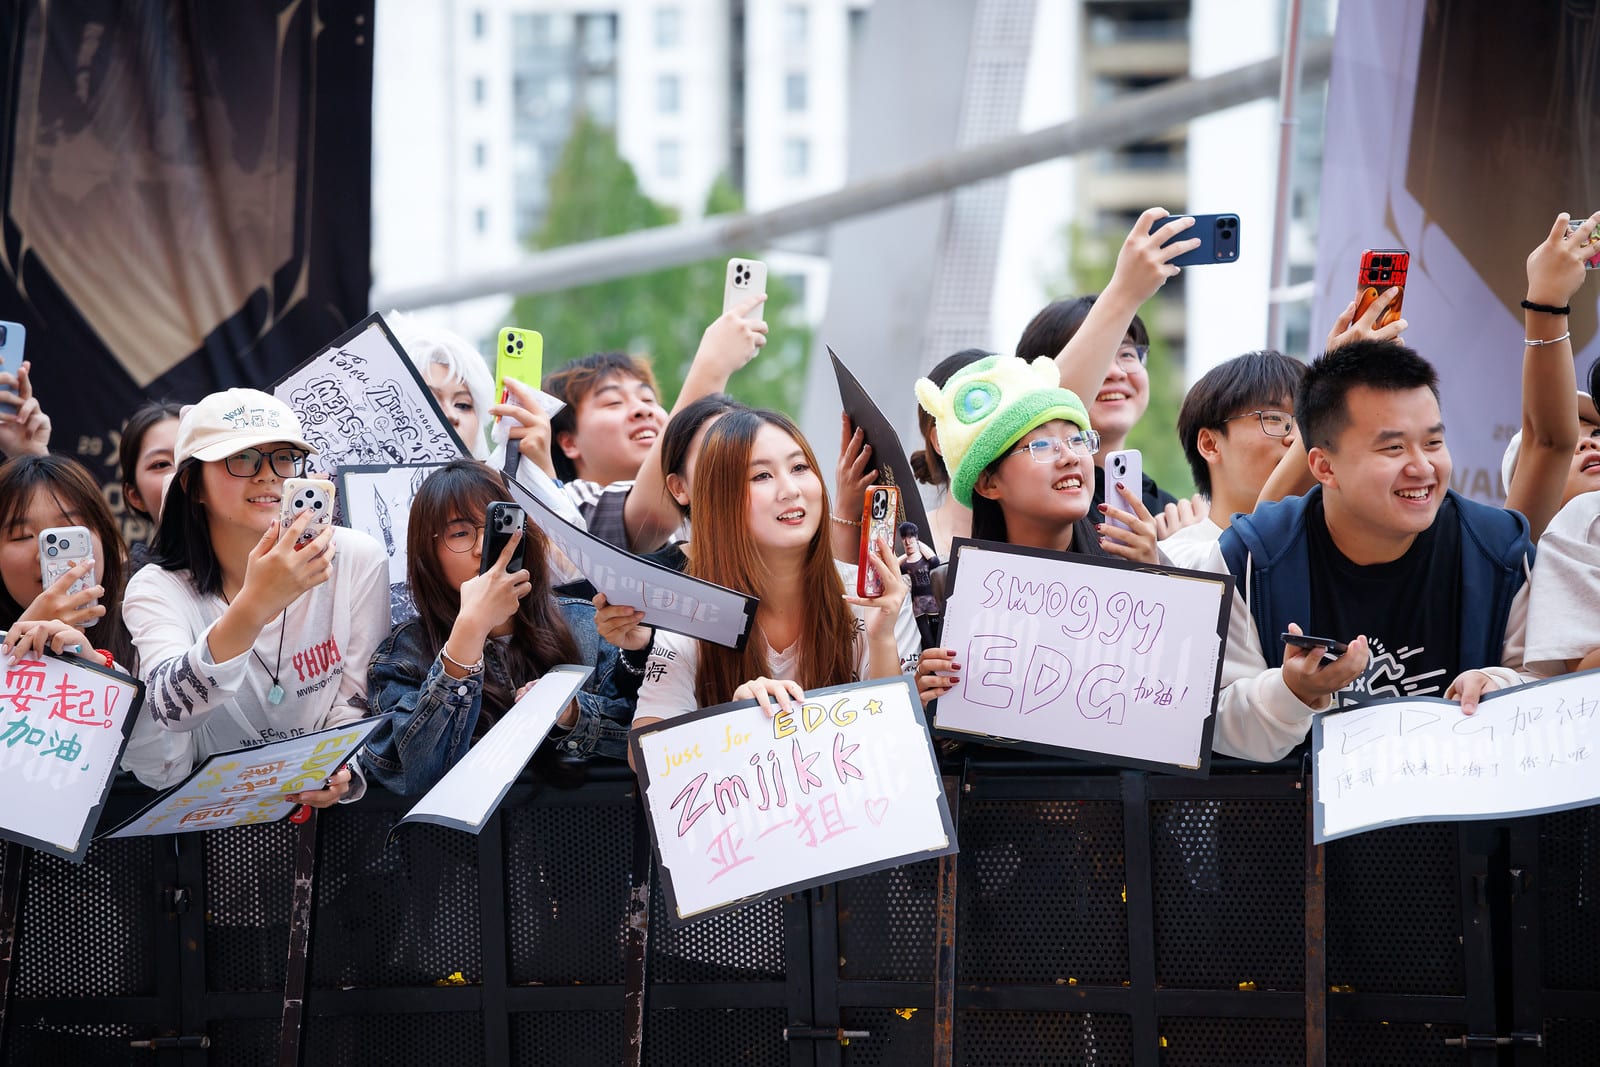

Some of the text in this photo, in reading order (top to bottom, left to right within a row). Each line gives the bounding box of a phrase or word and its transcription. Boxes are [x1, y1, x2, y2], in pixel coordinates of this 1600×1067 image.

[311, 380, 364, 438] STEW
[646, 661, 668, 683] 将
[963, 634, 1126, 725] EDG
[659, 698, 858, 778] just for EDG
[1341, 708, 1494, 755] EDG
[281, 731, 362, 794] EDG
